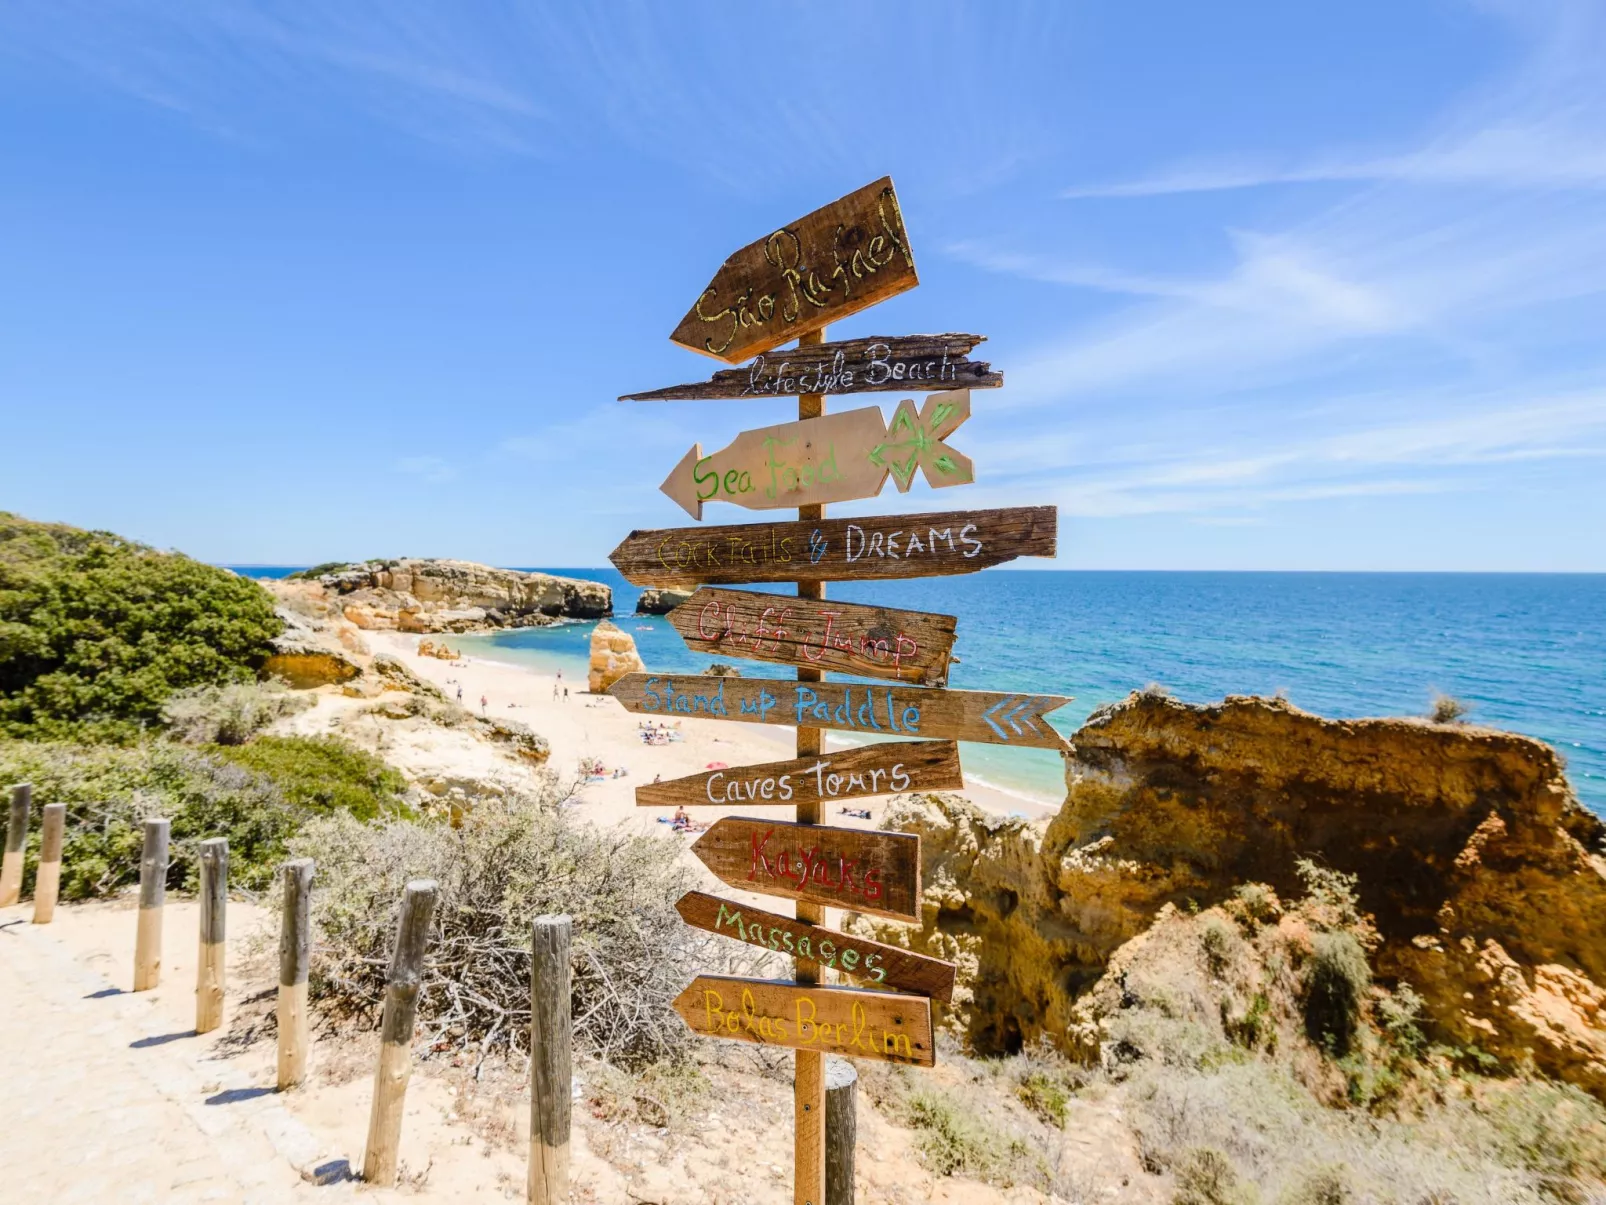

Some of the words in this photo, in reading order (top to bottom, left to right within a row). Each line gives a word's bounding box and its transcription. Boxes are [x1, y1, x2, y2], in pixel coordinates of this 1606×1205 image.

[696, 288, 775, 353] São
[764, 187, 913, 323] Rafael
[865, 343, 956, 384] Beach
[693, 456, 755, 500] Sea
[762, 434, 843, 500] Food
[808, 528, 828, 564] &
[698, 601, 793, 652] Cliff
[803, 611, 918, 678] Jump
[643, 678, 728, 715] Stand
[740, 687, 776, 721] up
[794, 685, 921, 732] Paddle
[706, 772, 793, 804] Caves
[804, 760, 911, 798] Tours
[715, 903, 887, 983] Massages
[703, 988, 788, 1040] Bolas
[795, 997, 912, 1057] Berlim
